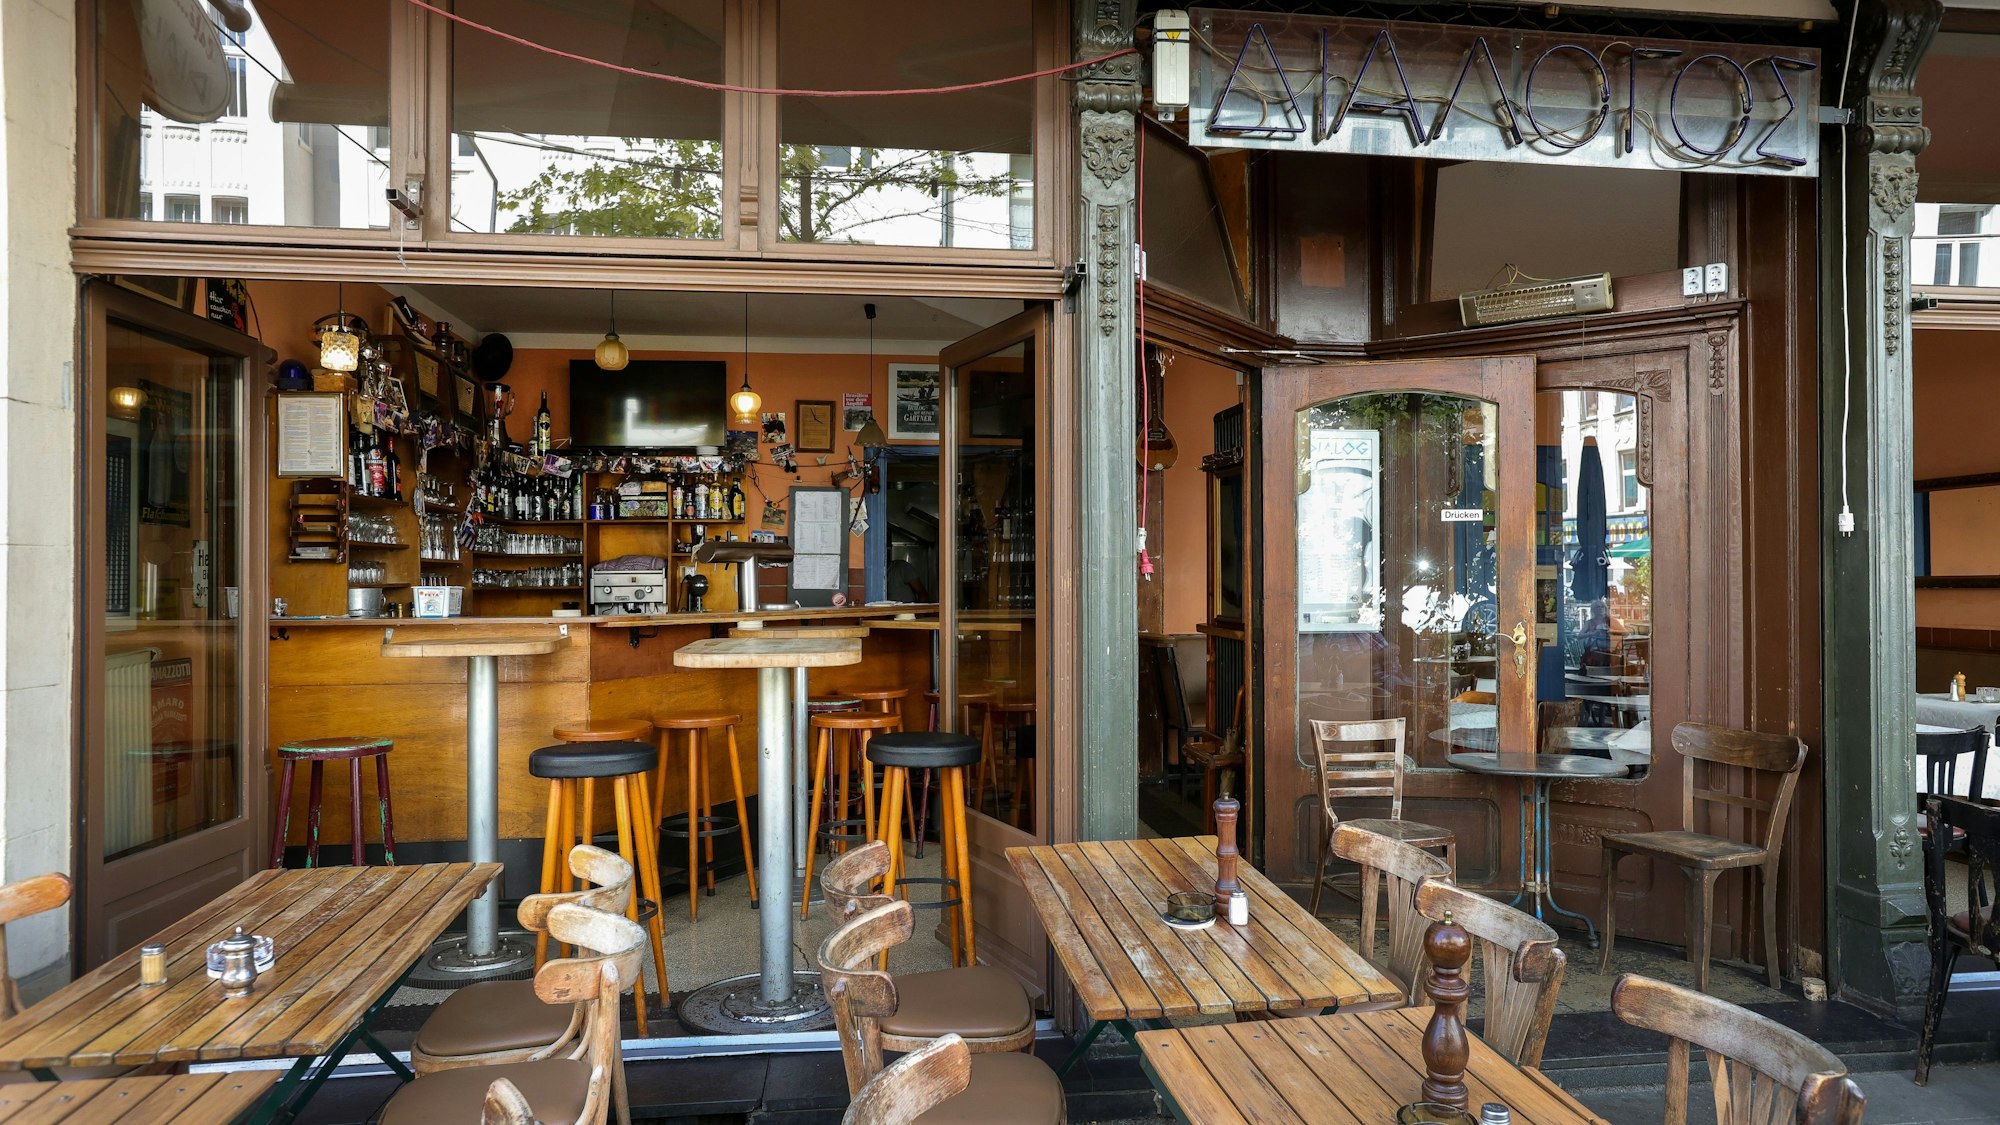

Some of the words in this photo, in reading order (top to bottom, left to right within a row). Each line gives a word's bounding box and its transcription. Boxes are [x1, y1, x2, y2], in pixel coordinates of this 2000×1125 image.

[1444, 510, 1480, 519] Drücken
[151, 663, 191, 681] AMAZZOTTI
[152, 697, 185, 716] AMARO
